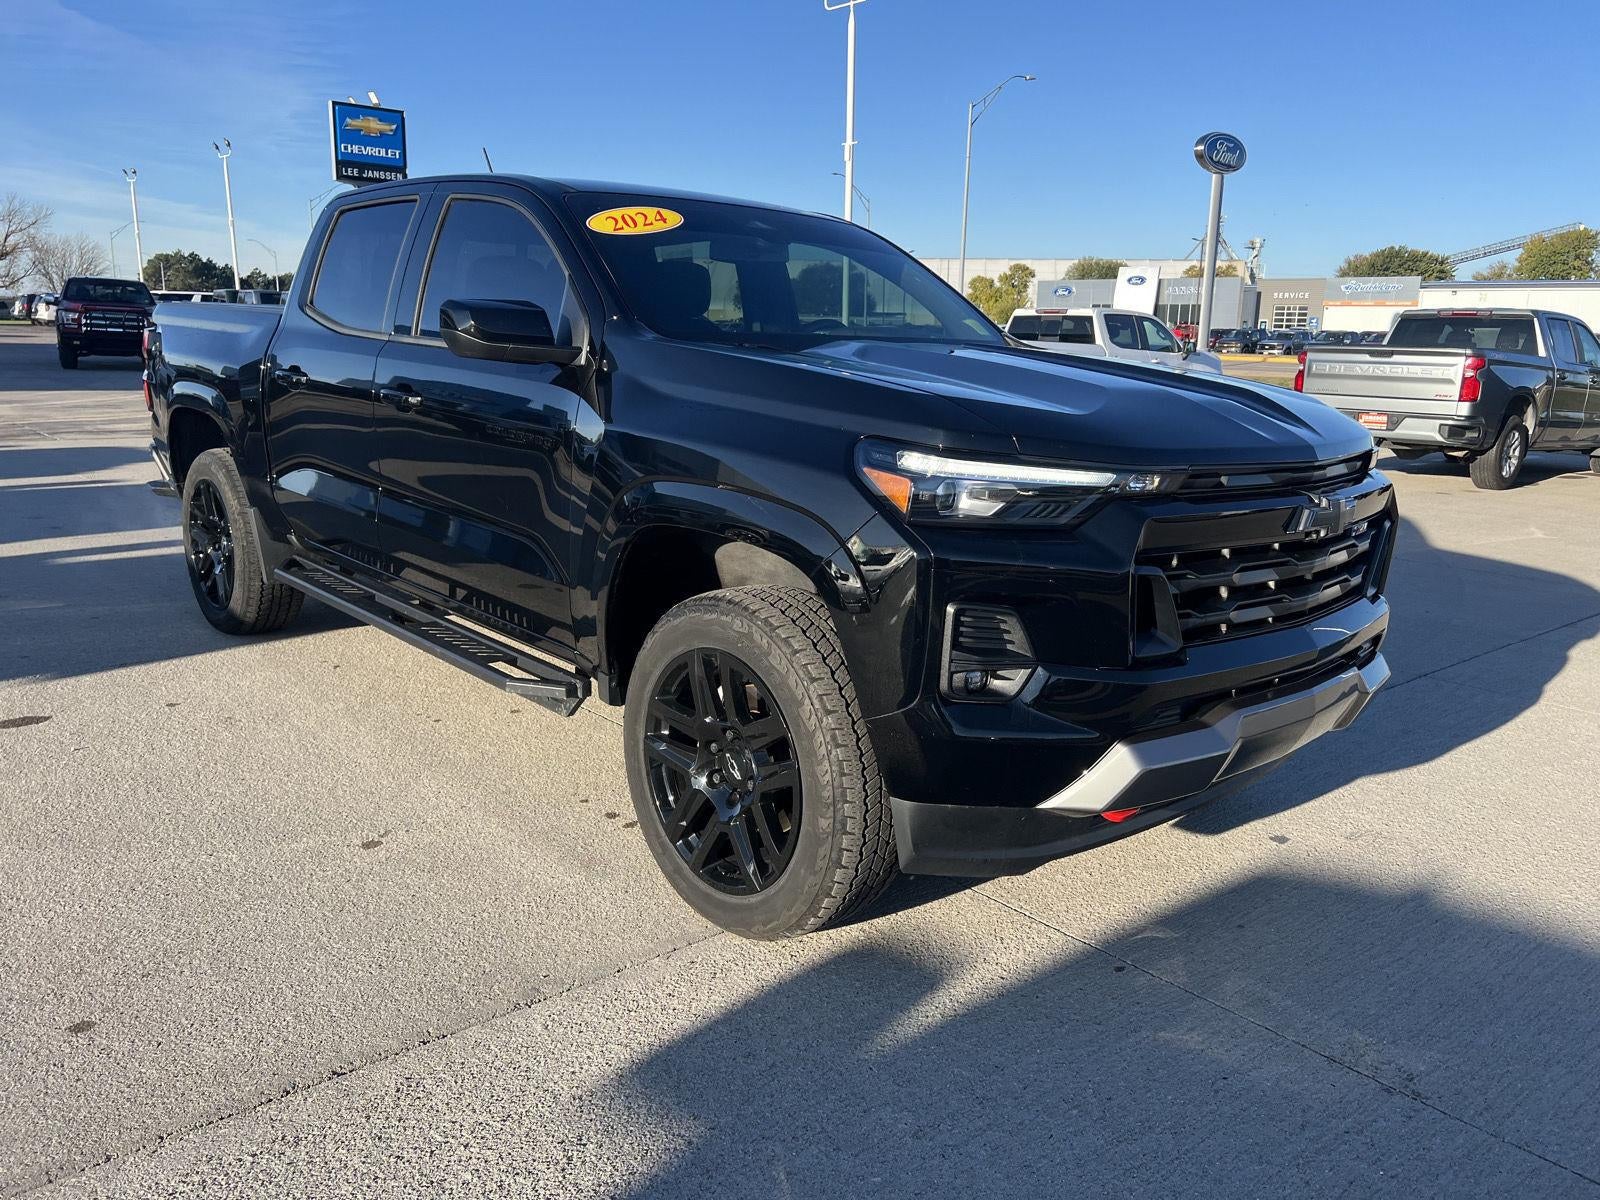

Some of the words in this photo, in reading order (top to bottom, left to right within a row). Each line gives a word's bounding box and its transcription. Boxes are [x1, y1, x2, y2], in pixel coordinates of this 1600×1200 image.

[341, 143, 401, 159] CHEVROLET
[1213, 139, 1240, 165] Ford
[342, 167, 359, 177] LEE
[362, 170, 403, 180] JANSSEN
[605, 209, 668, 232] 2024
[1312, 363, 1452, 377] CHEVROLET
